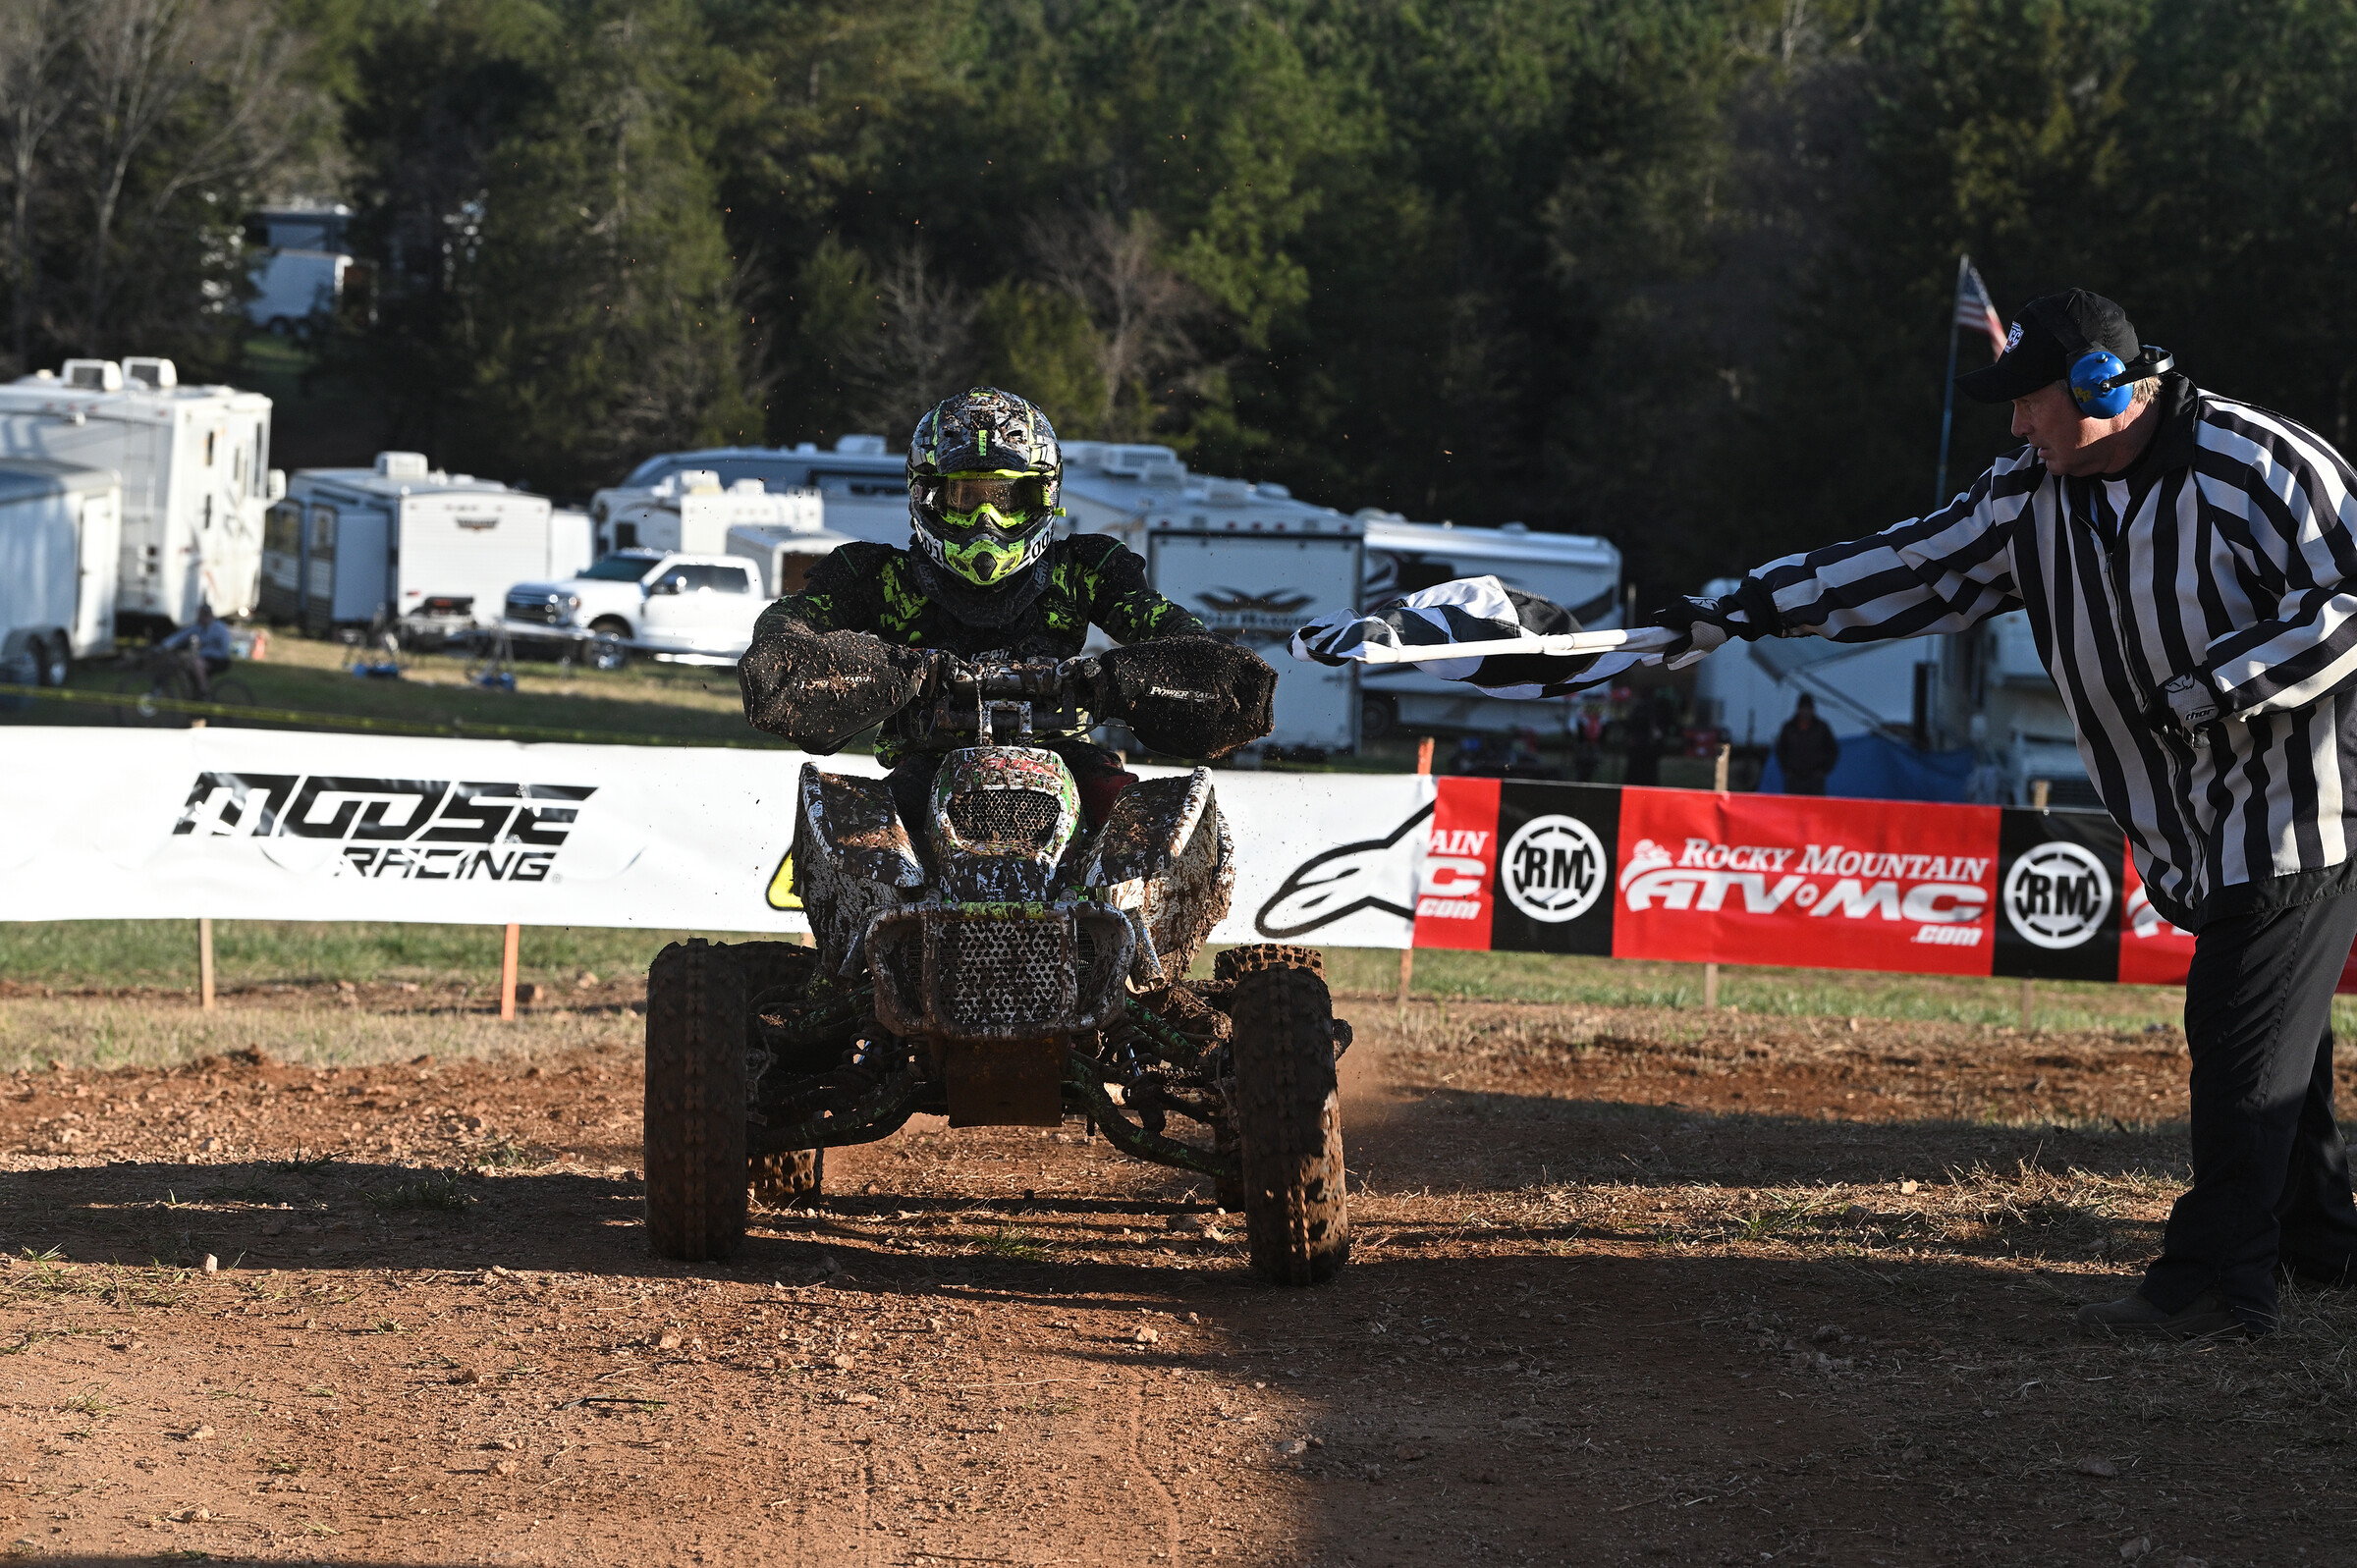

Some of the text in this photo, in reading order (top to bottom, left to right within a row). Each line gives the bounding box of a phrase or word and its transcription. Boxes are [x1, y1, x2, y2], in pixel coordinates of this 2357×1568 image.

[2185, 708, 2215, 721] thor
[172, 772, 598, 846] MOOSE
[333, 847, 557, 882] RACING
[1524, 847, 1585, 889] RM
[1676, 837, 1990, 883] ROCKY MOUNTAIN
[2027, 874, 2089, 915] RM
[1910, 924, 1984, 946] .com
